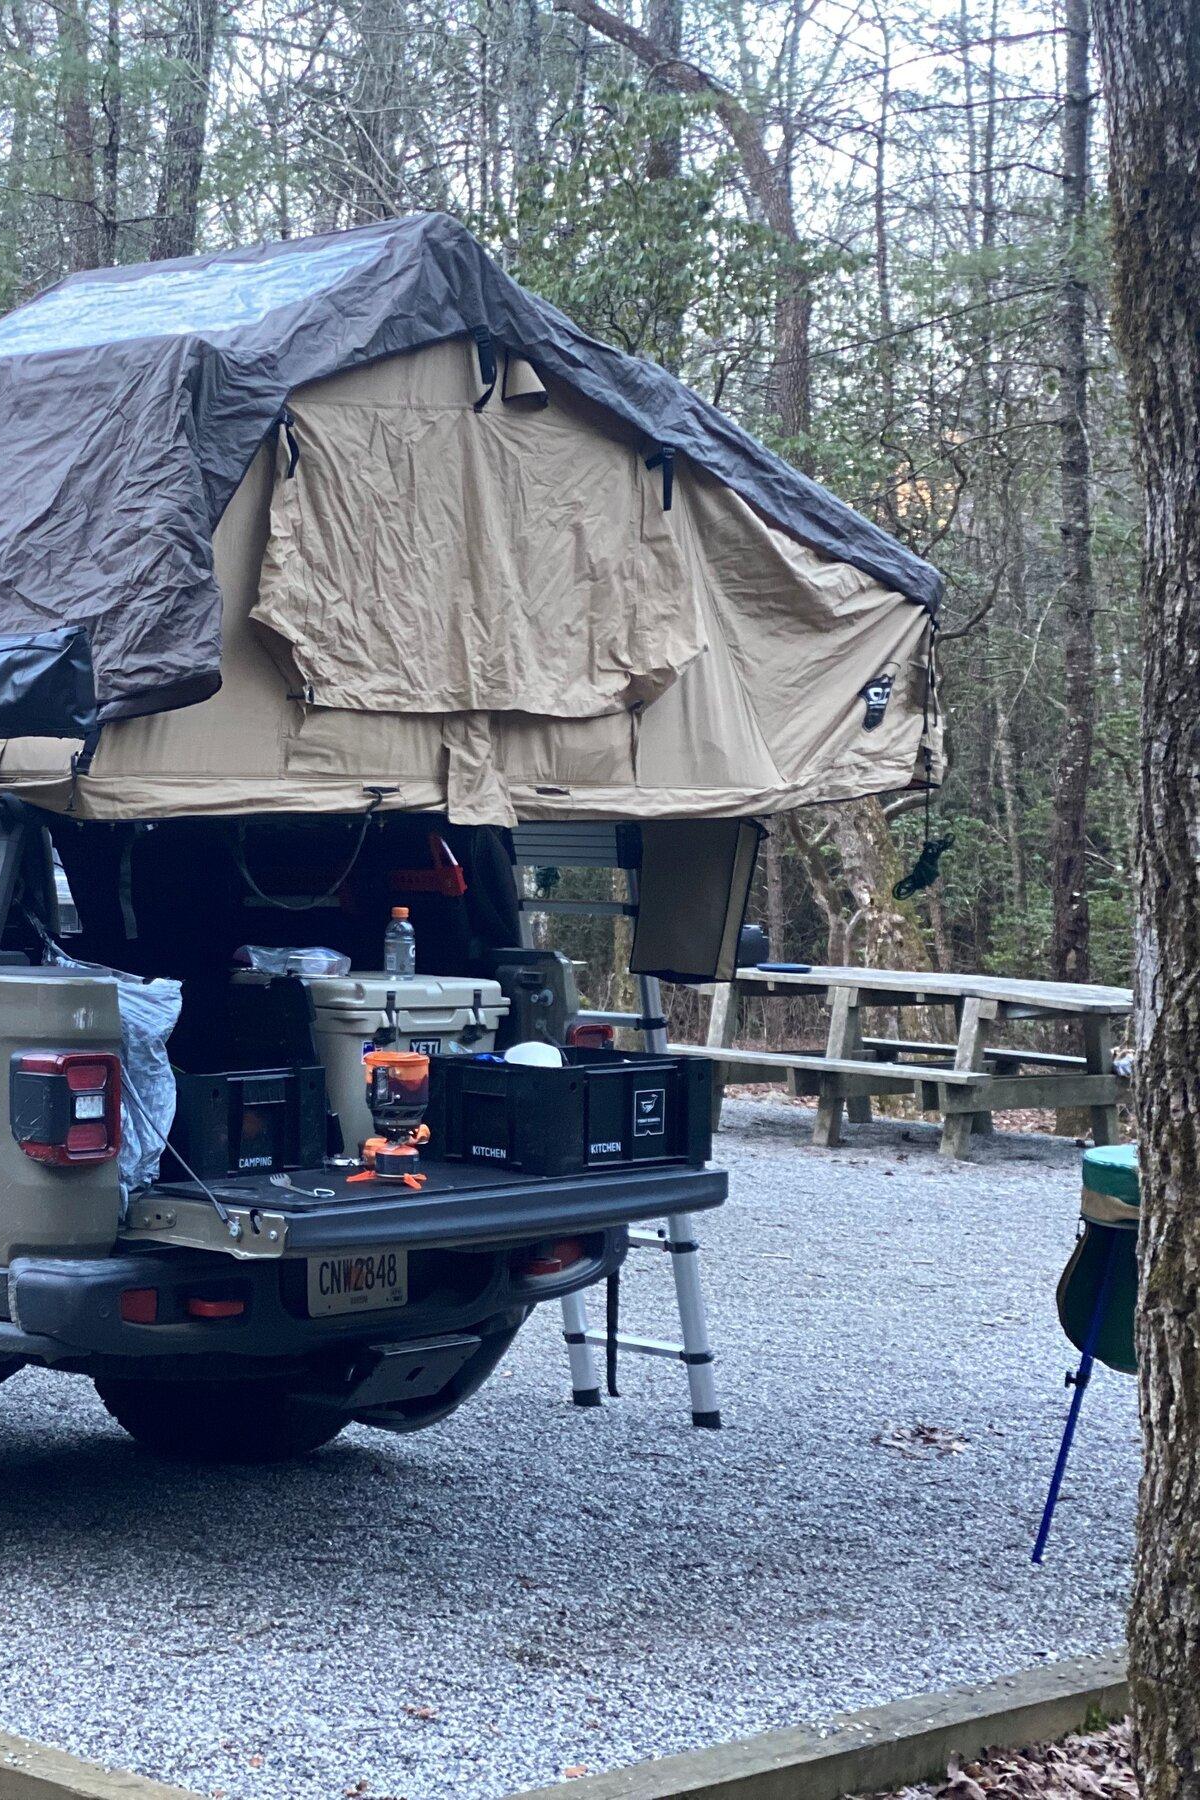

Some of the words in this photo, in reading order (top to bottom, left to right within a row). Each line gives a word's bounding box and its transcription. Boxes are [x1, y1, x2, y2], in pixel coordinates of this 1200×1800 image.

[411, 1041, 440, 1055] YETI
[472, 1145, 507, 1159] KITCHEN
[590, 1142, 622, 1154] KITCHEN
[238, 1156, 273, 1168] CAMPING
[319, 1253, 397, 1296] CNW2848
